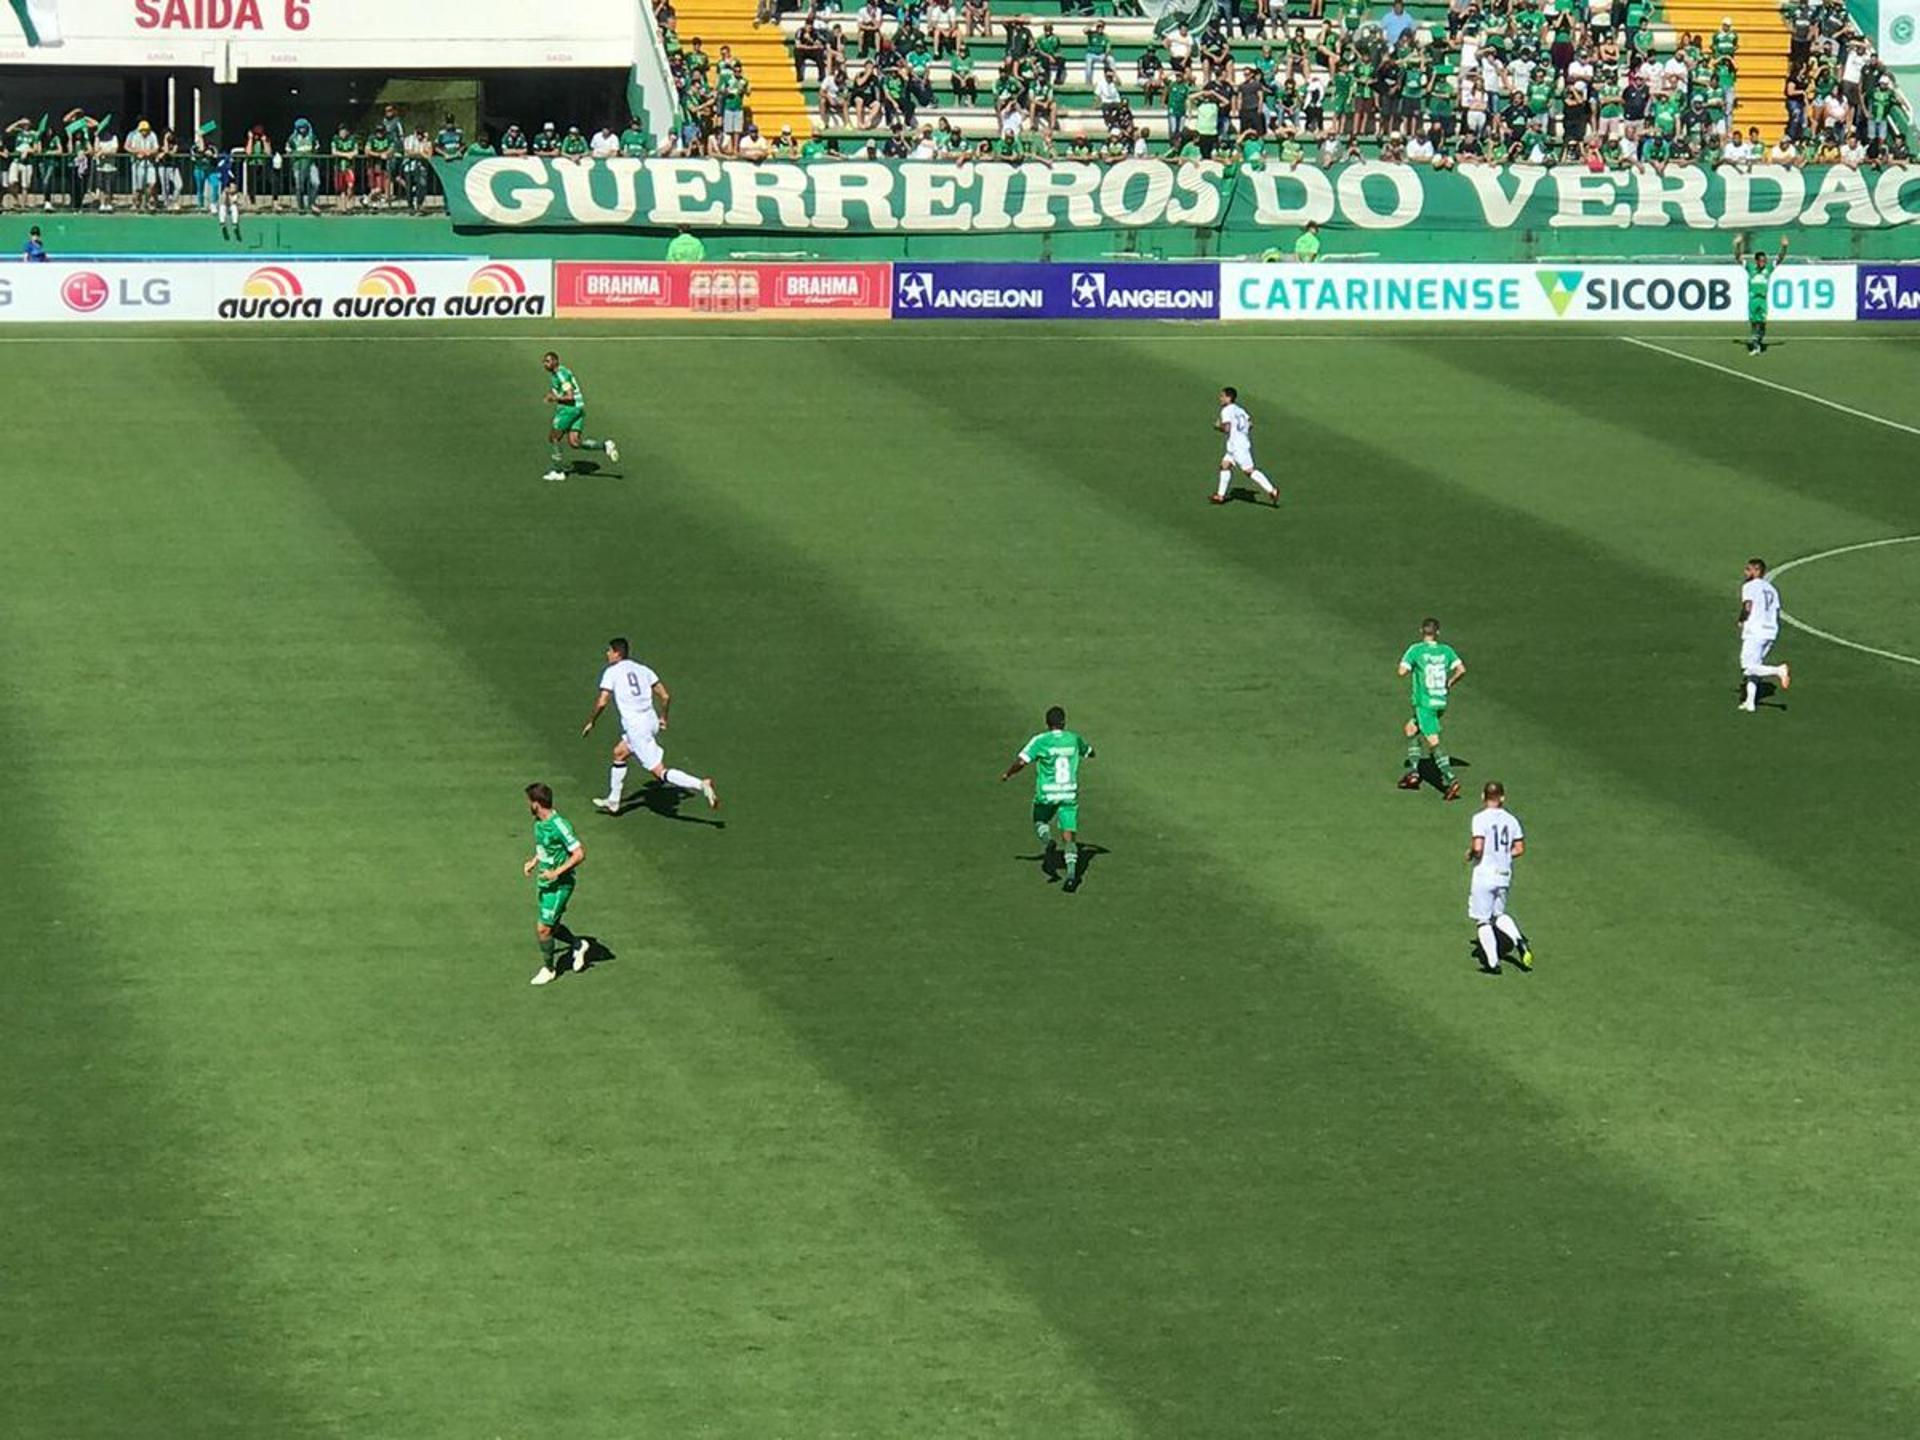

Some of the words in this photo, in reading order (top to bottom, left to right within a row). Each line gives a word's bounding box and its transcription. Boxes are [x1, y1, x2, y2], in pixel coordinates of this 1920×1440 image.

[285, 0, 310, 31] 6
[464, 156, 1224, 227] GUERREIROS
[1242, 160, 1424, 229] DO
[119, 278, 171, 306] LG
[587, 275, 660, 295] BRAHMA
[787, 276, 859, 296] BRAHMA
[1239, 278, 1520, 310] CATARINENSE
[1586, 278, 1731, 310] SICOOB
[1772, 278, 1836, 310] 019
[218, 298, 322, 319] aurora
[333, 296, 436, 318] aurora
[444, 295, 545, 316] aurora
[934, 289, 1043, 308] ANGELONI
[1106, 289, 1214, 308] ANGELONI
[627, 672, 641, 697] 9
[1055, 756, 1070, 784] 8
[1492, 824, 1509, 853] 14
